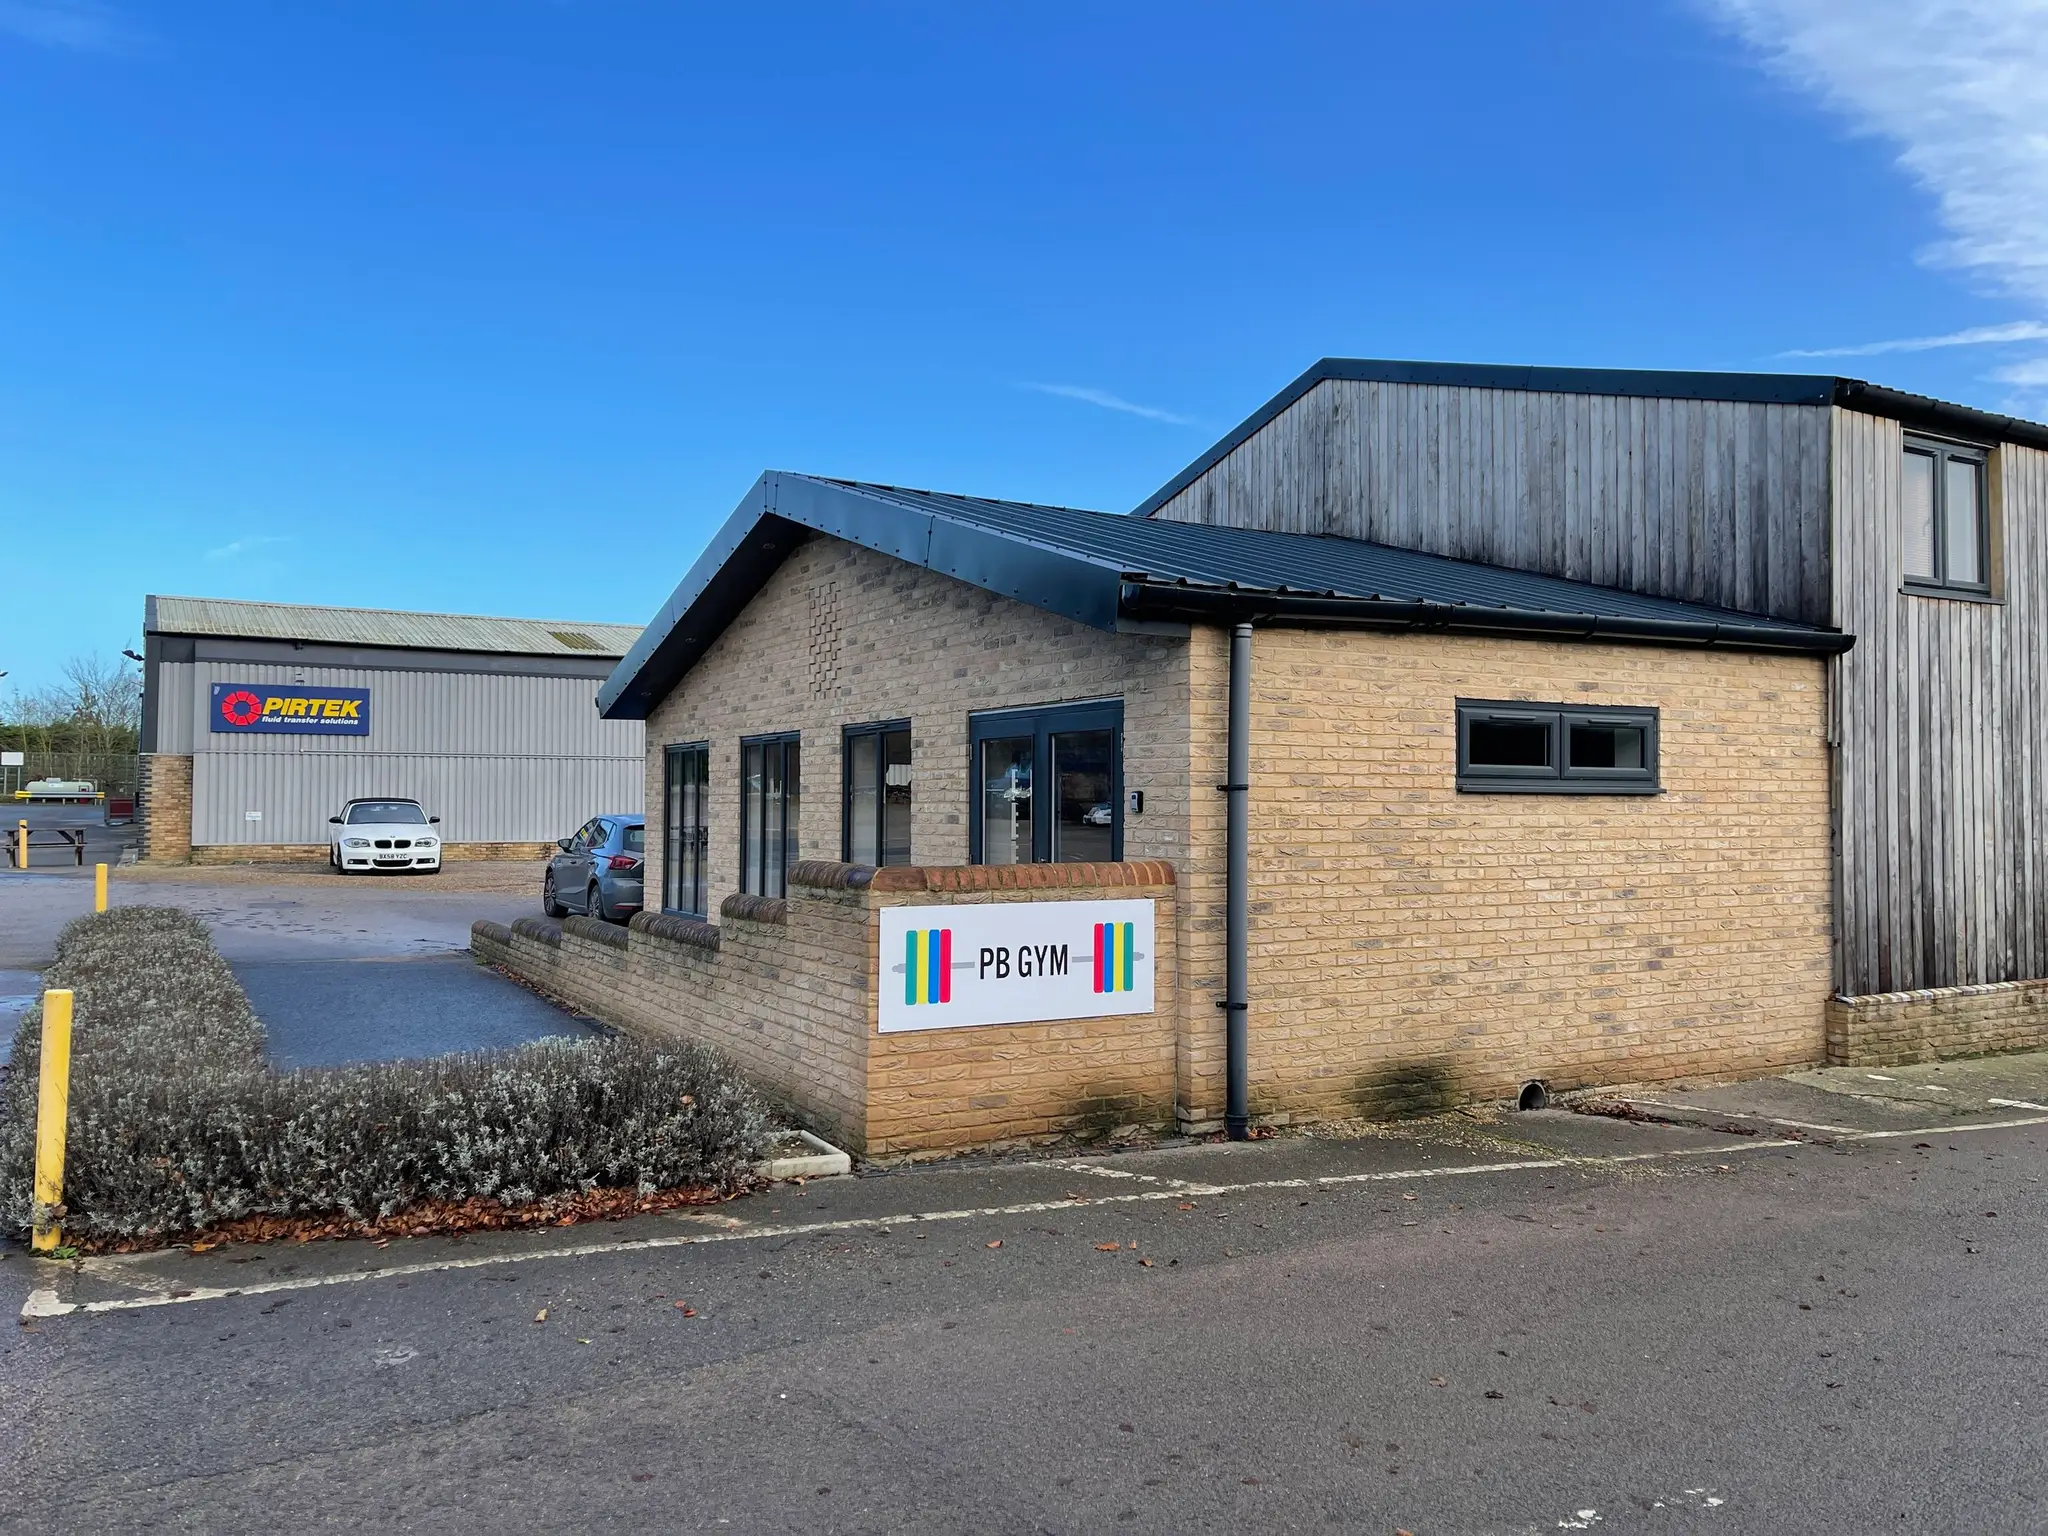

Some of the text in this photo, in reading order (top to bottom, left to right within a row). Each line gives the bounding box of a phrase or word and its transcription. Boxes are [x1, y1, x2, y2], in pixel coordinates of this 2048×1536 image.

[262, 697, 362, 717] PIRTEK
[320, 717, 359, 725] solutions
[980, 944, 1069, 980] PB GYM
